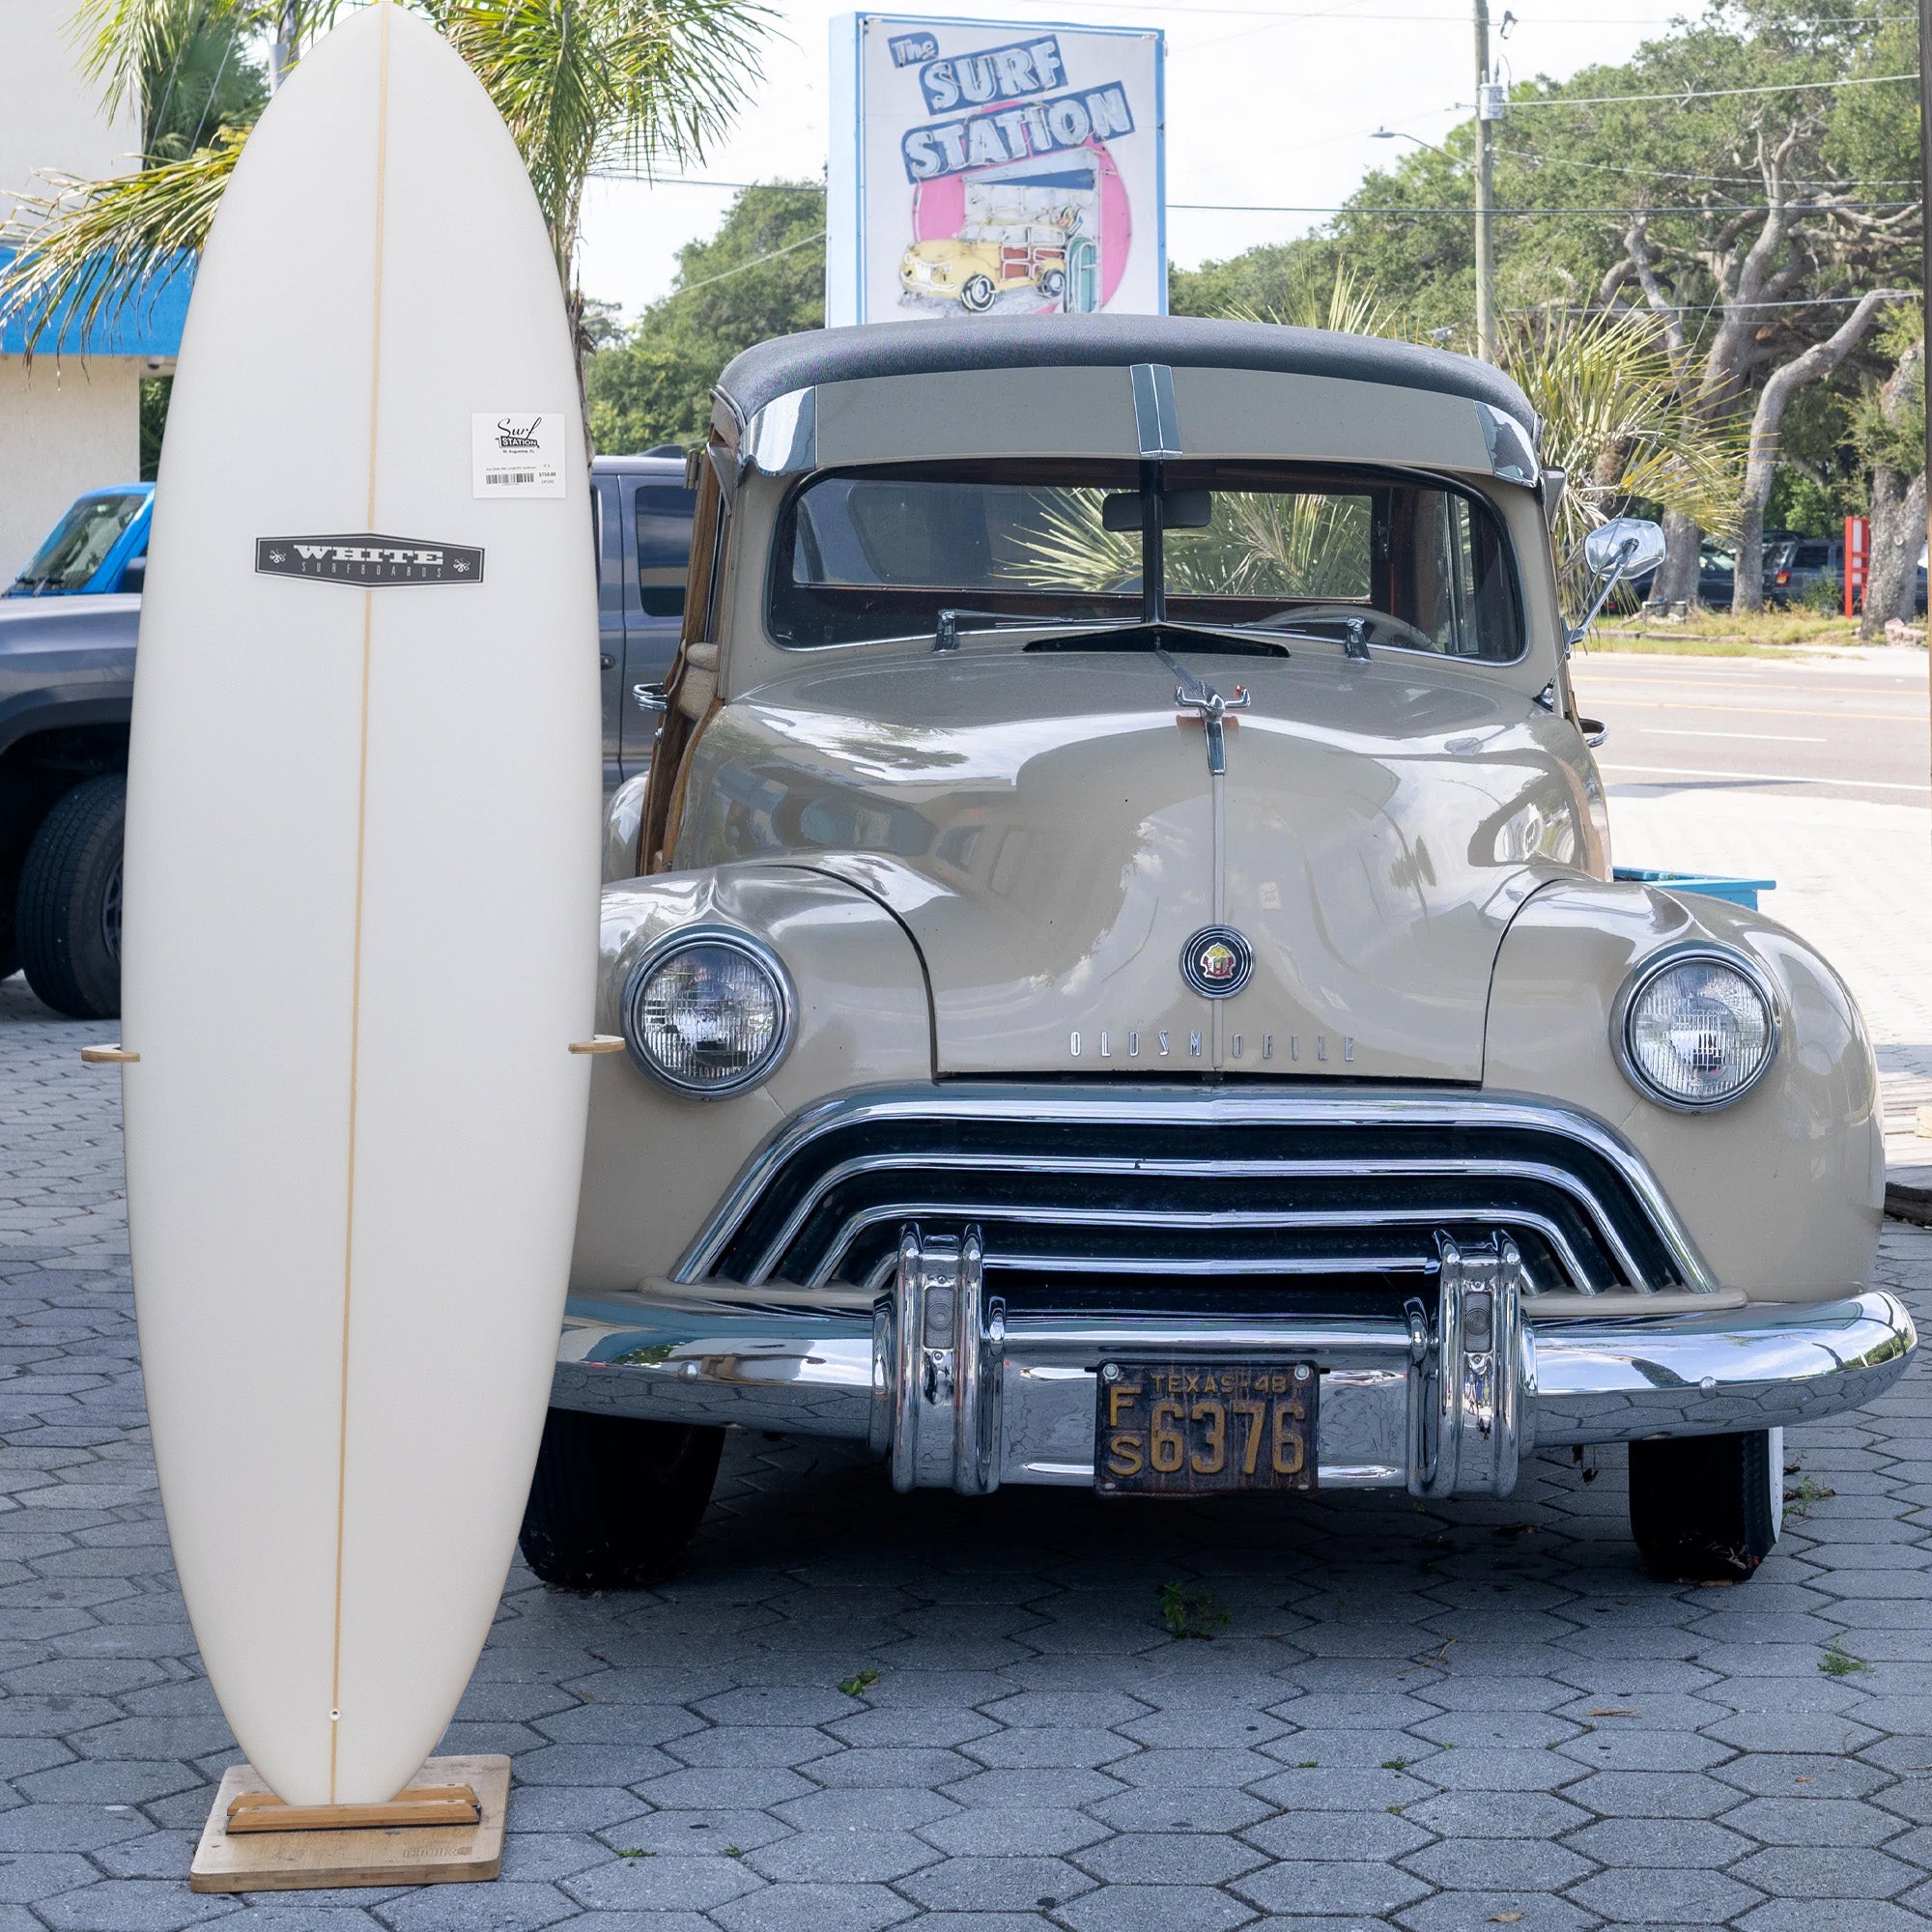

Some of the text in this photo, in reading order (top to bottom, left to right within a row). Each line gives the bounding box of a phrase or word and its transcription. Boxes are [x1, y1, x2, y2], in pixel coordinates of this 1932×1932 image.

[892, 37, 936, 62] The
[922, 41, 1063, 111] SURF
[904, 87, 1131, 179] STATION
[497, 416, 542, 440] Surf
[501, 437, 538, 447] STATION
[293, 545, 443, 565] WHITE
[300, 561, 443, 579] SURFBOARDS
[1069, 1030, 1355, 1062] OLDSMOBILE
[1150, 1401, 1305, 1475] 6376
